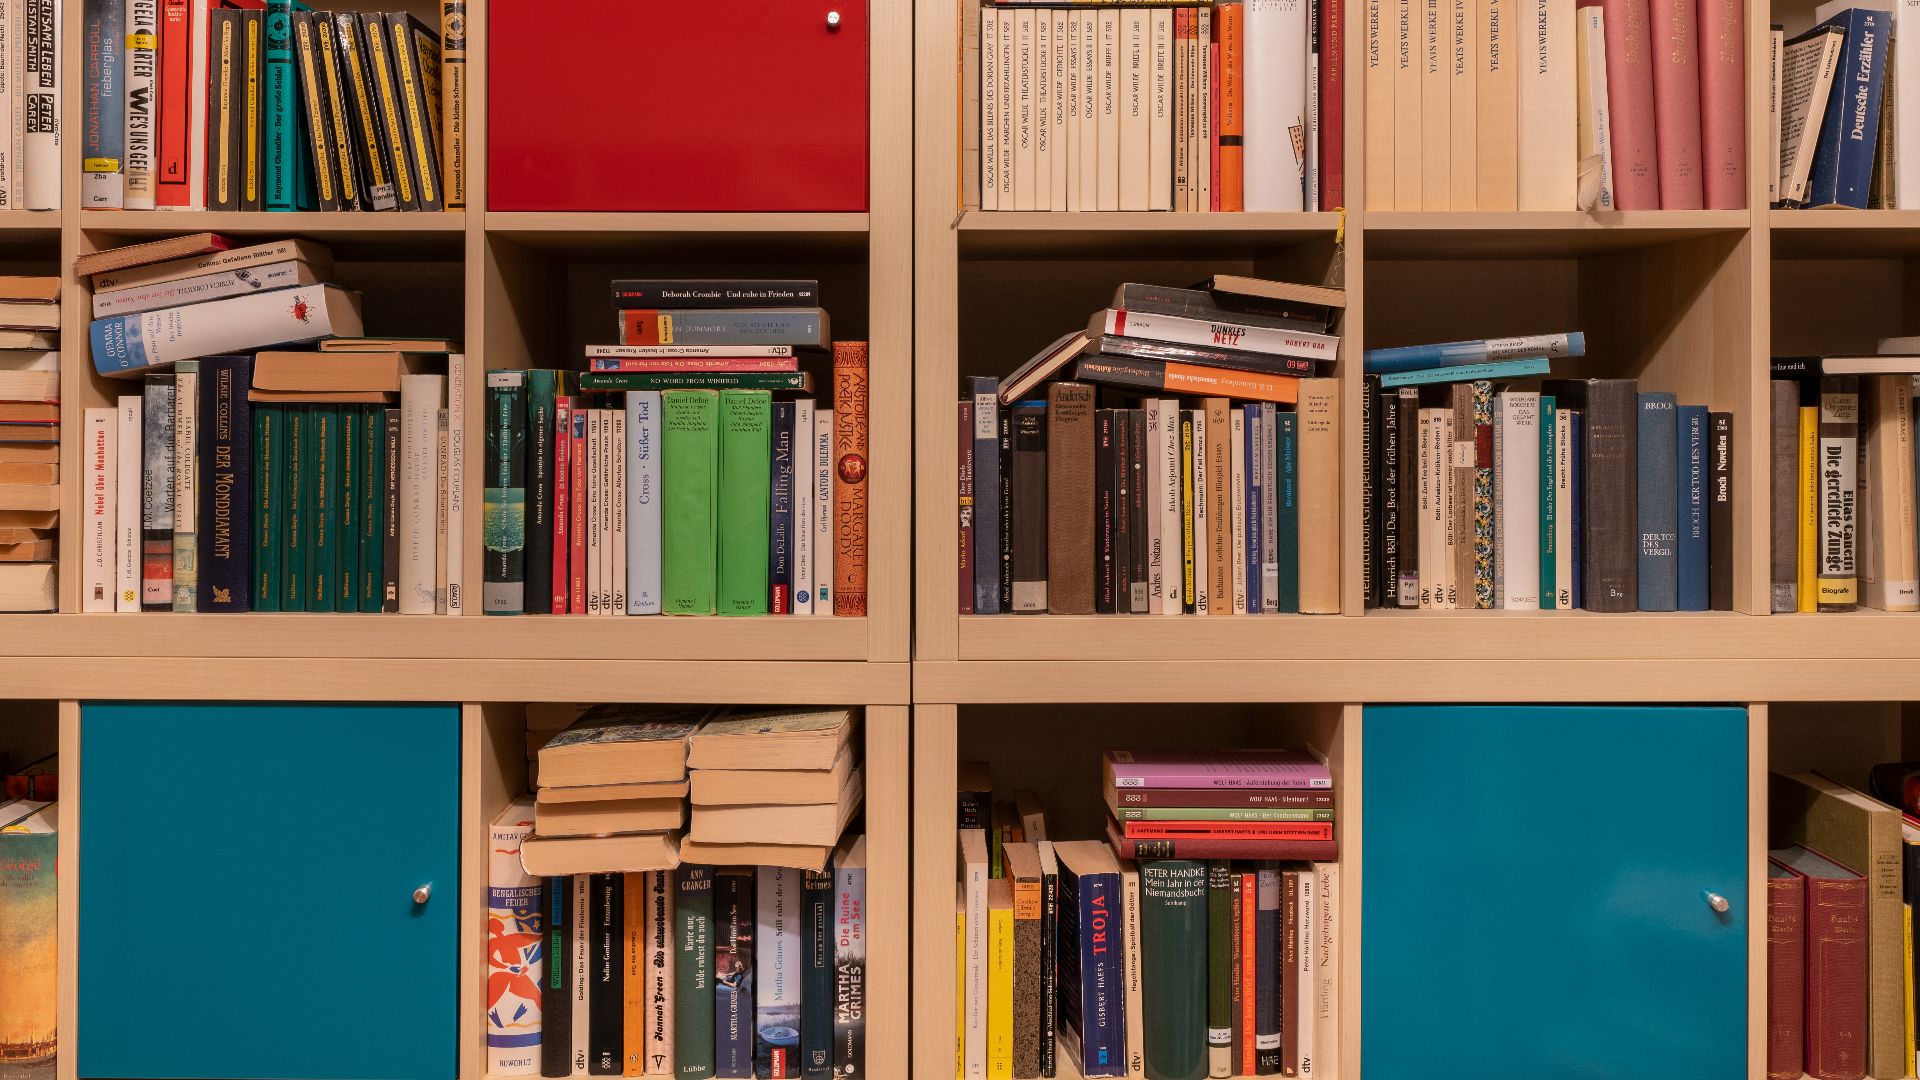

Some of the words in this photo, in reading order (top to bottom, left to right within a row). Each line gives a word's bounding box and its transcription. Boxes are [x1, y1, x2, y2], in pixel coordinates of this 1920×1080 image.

[1429, 11, 1437, 43] WERKE
[28, 37, 36, 70] SMITH
[90, 20, 99, 77] CARROLL
[1429, 46, 1437, 73] YEATS
[1857, 31, 1874, 81] Erzähler
[42, 51, 52, 85] LEBEN
[102, 39, 112, 97] fieberglas
[28, 96, 36, 131] CAREY
[41, 96, 52, 130] PETER
[90, 83, 99, 150] JONATHAN
[1851, 86, 1868, 140] Deutsche
[1600, 191, 1610, 206] dtv
[100, 279, 115, 288] dtv
[106, 324, 115, 357] GEMMA
[1211, 325, 1246, 337] DUNKLES
[1213, 334, 1239, 346] NETZ
[114, 323, 128, 367] O'CONNOR
[772, 348, 787, 356] dtv
[220, 403, 228, 439] COLLINS
[639, 402, 649, 423] Tod
[1387, 404, 1396, 429] Jahre
[95, 431, 104, 471] Manhattan
[165, 436, 174, 451] die
[639, 427, 649, 460] Süßer
[776, 432, 788, 461] Man
[820, 434, 828, 466] DILEMMA
[1387, 434, 1396, 464] frühen
[1718, 436, 1727, 470] Novellen
[165, 456, 174, 472] auf
[216, 446, 230, 467] DER
[1692, 448, 1700, 464] DES
[1826, 446, 1841, 466] Die
[95, 475, 104, 490] über
[820, 470, 828, 501] CANTORS
[1387, 469, 1396, 484] der
[1692, 467, 1700, 484] TOD
[144, 470, 153, 510] Coetzee
[165, 477, 174, 512] Warten
[640, 474, 649, 504] Cross
[775, 466, 792, 513] Falling
[1387, 488, 1396, 508] Brot
[1692, 486, 1700, 504] DER
[1718, 477, 1727, 501] Broch
[1825, 470, 1842, 528] gerettete
[95, 494, 104, 515] Nebel
[1168, 490, 1176, 513] Jakob
[1843, 490, 1853, 521] Elias
[216, 473, 233, 558] MONDDIAMANT
[1387, 512, 1396, 529] Das
[1692, 508, 1700, 538] BROCH
[776, 524, 785, 554] DeLillo
[840, 501, 851, 557] DOODY
[1151, 539, 1161, 567] Positano
[1387, 535, 1396, 553] Böll
[1825, 531, 1842, 571] Zunge
[1843, 525, 1853, 570] Canetti
[776, 557, 785, 574] Don
[1151, 573, 1161, 598] Andres
[1387, 557, 1396, 598] Heinrich
[590, 594, 599, 610] dtv
[602, 594, 610, 610] dtv
[614, 594, 622, 610] dtv
[1199, 595, 1207, 610] dtv
[1235, 594, 1244, 609] dtv
[1421, 589, 1429, 604] dtv
[1435, 588, 1443, 603] dtv
[1560, 590, 1569, 605] dtv
[682, 879, 711, 890] GRANGER
[690, 870, 704, 878] ANN
[1145, 868, 1167, 878] PETER
[1171, 868, 1204, 878] HANDKE
[1145, 878, 1164, 887] Mein
[1168, 878, 1182, 888] Jahr
[1185, 878, 1191, 888] in
[493, 888, 541, 897] BENGALISCHES
[775, 884, 783, 896] der
[1145, 888, 1204, 897] Niemandsbucht
[1320, 874, 1330, 898] Liebe
[506, 898, 528, 906] FEUER
[775, 900, 783, 917] ruht
[840, 894, 850, 923] Ruine
[851, 900, 860, 919] See
[696, 916, 705, 932] auch
[775, 920, 783, 936] Still
[854, 923, 860, 939] am
[1092, 896, 1109, 955] TROJA
[1321, 901, 1332, 967] Nachgetragene
[684, 932, 694, 951] Warte
[696, 935, 705, 943] du
[840, 928, 850, 946] Die
[696, 946, 705, 967] ruhest
[775, 941, 783, 969] Grimes
[696, 969, 705, 988] balde
[775, 972, 783, 1000] Martha
[1097, 963, 1106, 988] HAEFS
[654, 977, 665, 1002] Green
[839, 964, 849, 1023] MARTHA
[851, 967, 862, 1019] GRIMES
[1097, 992, 1106, 1026] GISBERT
[654, 1005, 664, 1041] Hannah
[499, 1059, 531, 1067] ROWOHLT
[576, 1054, 584, 1069] dtv
[1132, 1056, 1141, 1071] dtv
[1302, 1058, 1310, 1073] dtv
